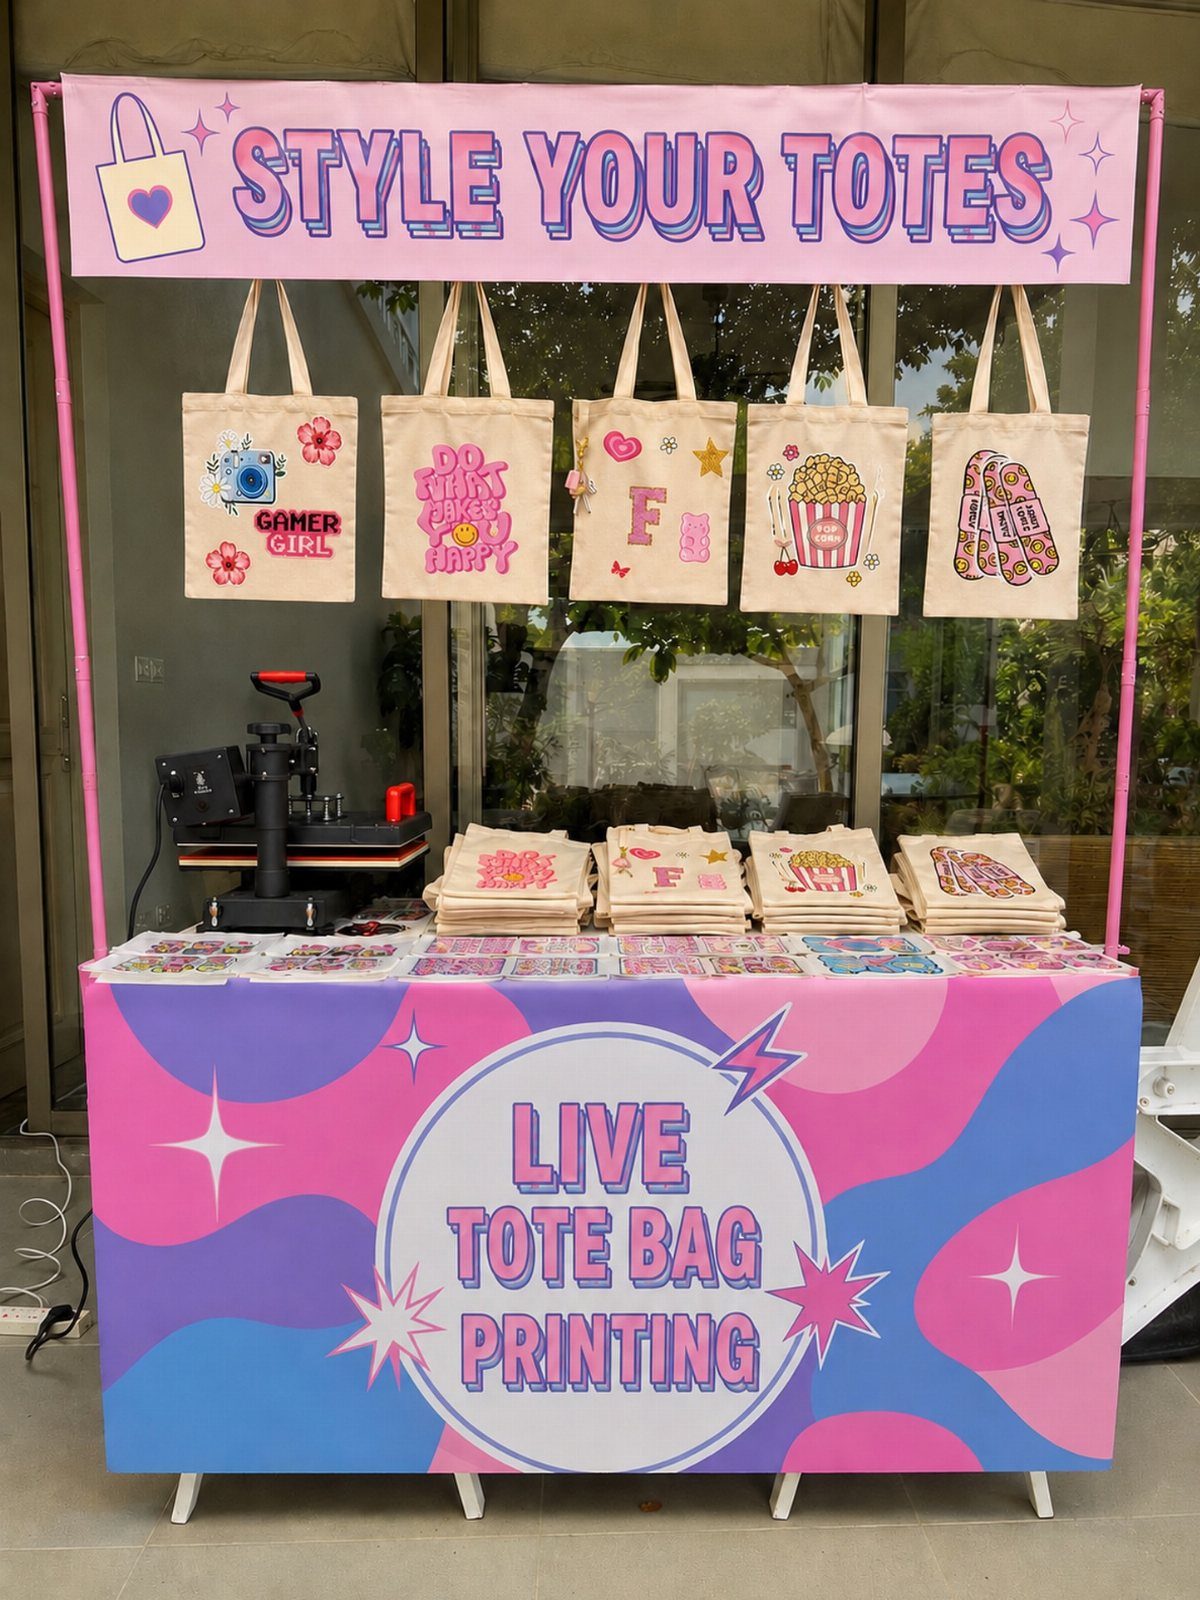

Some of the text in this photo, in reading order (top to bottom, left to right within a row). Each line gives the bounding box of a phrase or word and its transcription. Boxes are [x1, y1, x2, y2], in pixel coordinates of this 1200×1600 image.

[233, 126, 1052, 243] STYLE YOUR TOTES
[432, 443, 485, 476] DO
[256, 510, 340, 534] GAMER
[627, 486, 667, 546] F
[269, 533, 331, 555] GIRL
[425, 541, 518, 574] HAPPY
[652, 867, 684, 888] F
[512, 1102, 690, 1194] LIVE
[446, 1205, 763, 1289] TOTE BAG
[461, 1312, 760, 1393] PRINTING
